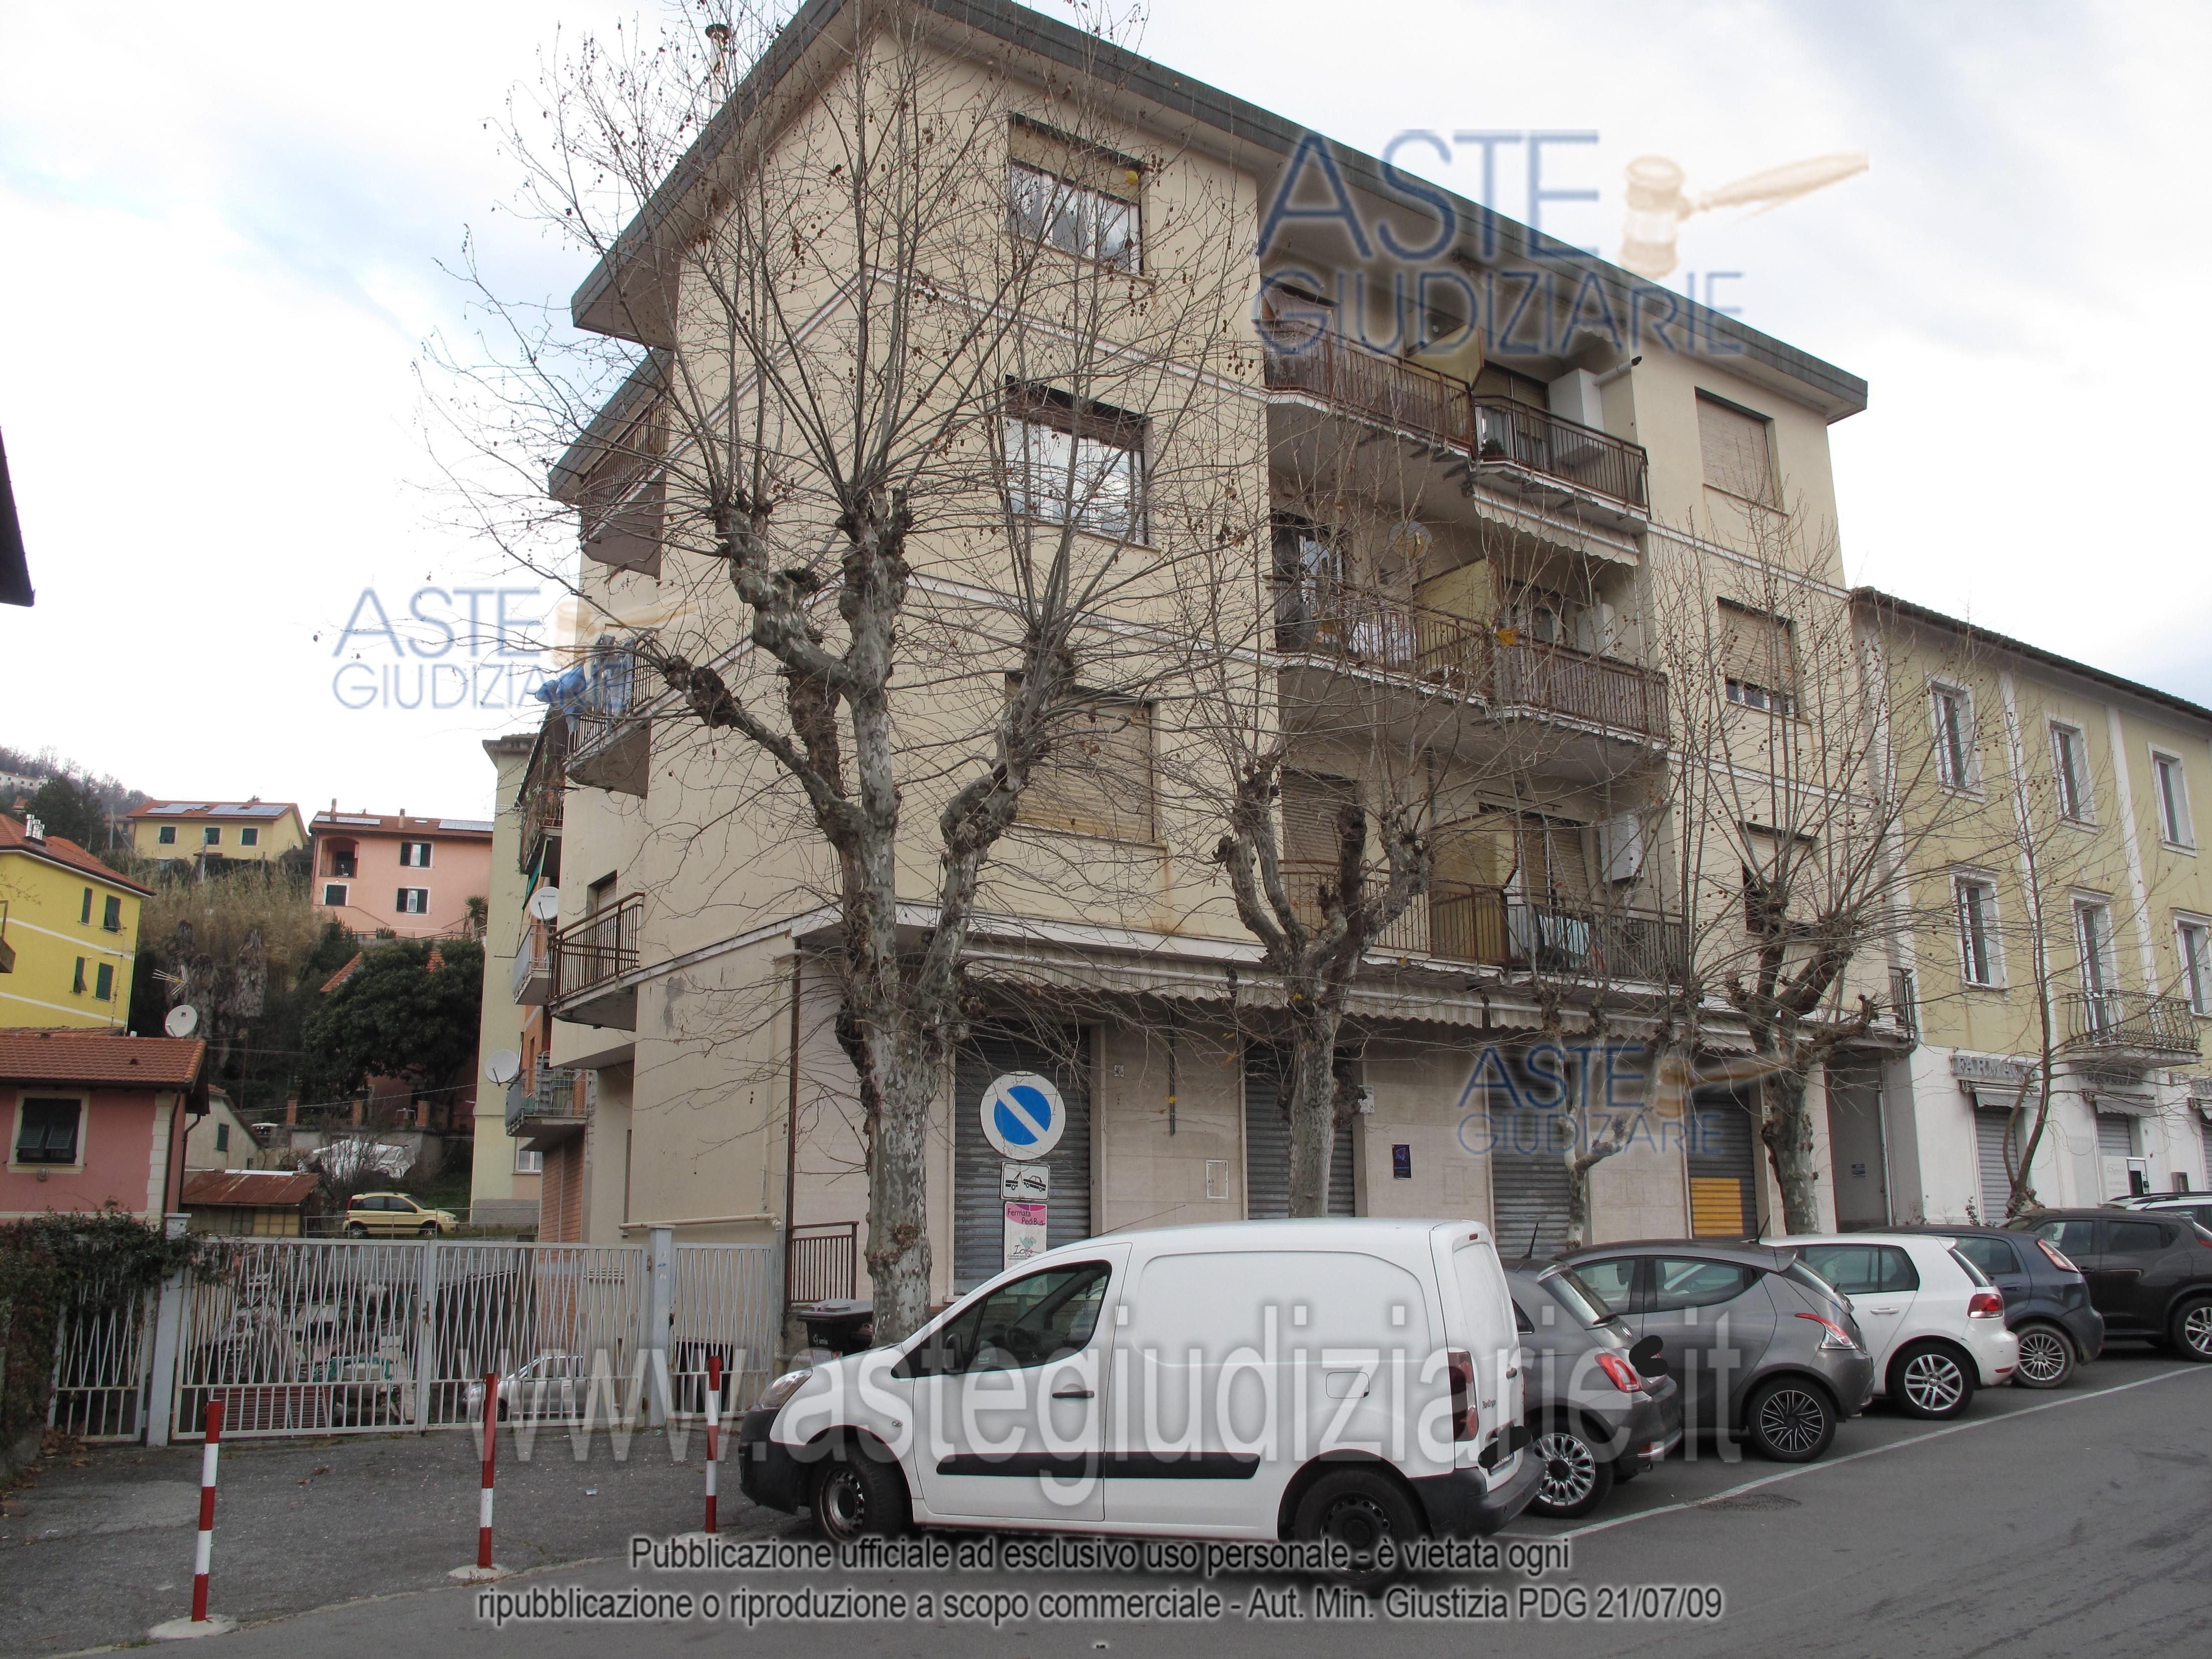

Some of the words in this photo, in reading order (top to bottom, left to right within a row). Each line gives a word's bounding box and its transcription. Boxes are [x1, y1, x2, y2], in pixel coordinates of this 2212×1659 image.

[1007, 1208, 1031, 1217] Fermata
[1021, 1217, 1044, 1226] PediBus
[1013, 1244, 1025, 1255] Io
